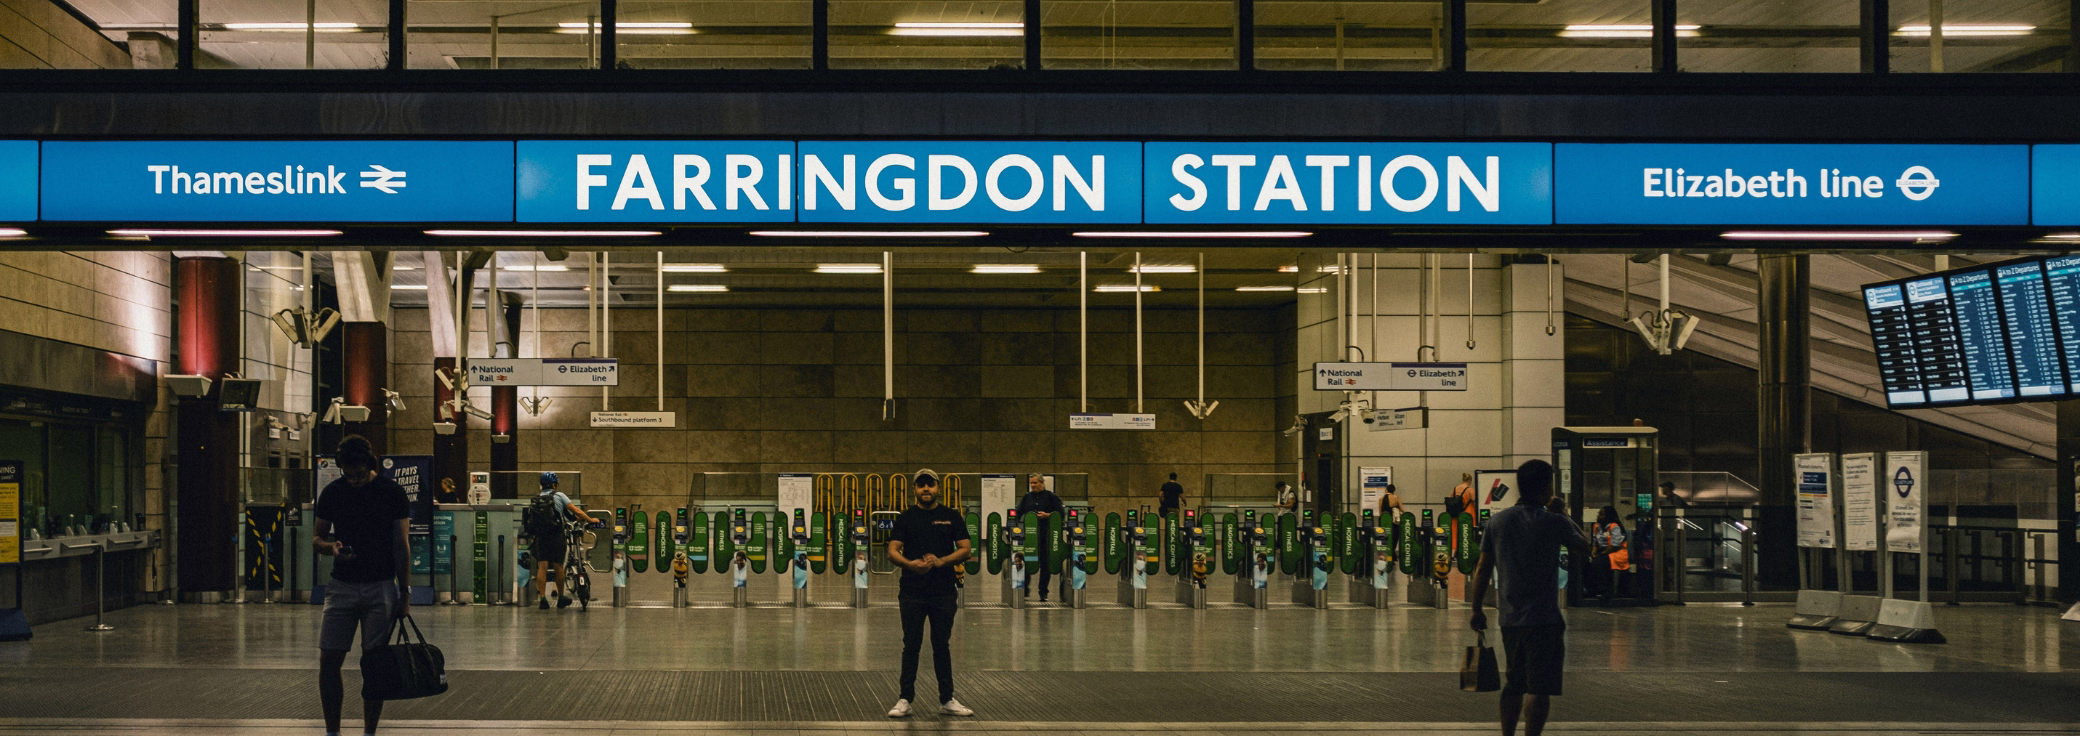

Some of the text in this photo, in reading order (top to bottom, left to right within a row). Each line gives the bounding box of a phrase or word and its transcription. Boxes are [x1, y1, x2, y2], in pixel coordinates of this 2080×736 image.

[148, 165, 346, 194] Thameslink
[577, 154, 1500, 212] FARRINGDON STATION
[1644, 167, 1883, 198] Elizabeth line
[2015, 265, 2040, 275] Departures
[479, 365, 514, 373] National
[570, 365, 607, 373] Elizabeth
[1328, 369, 1363, 377] National
[1419, 370, 1456, 378] Elizabeth
[1328, 378, 1343, 386] Rail
[395, 466, 418, 477] IT PAYS
[398, 475, 420, 485] TRAVEL
